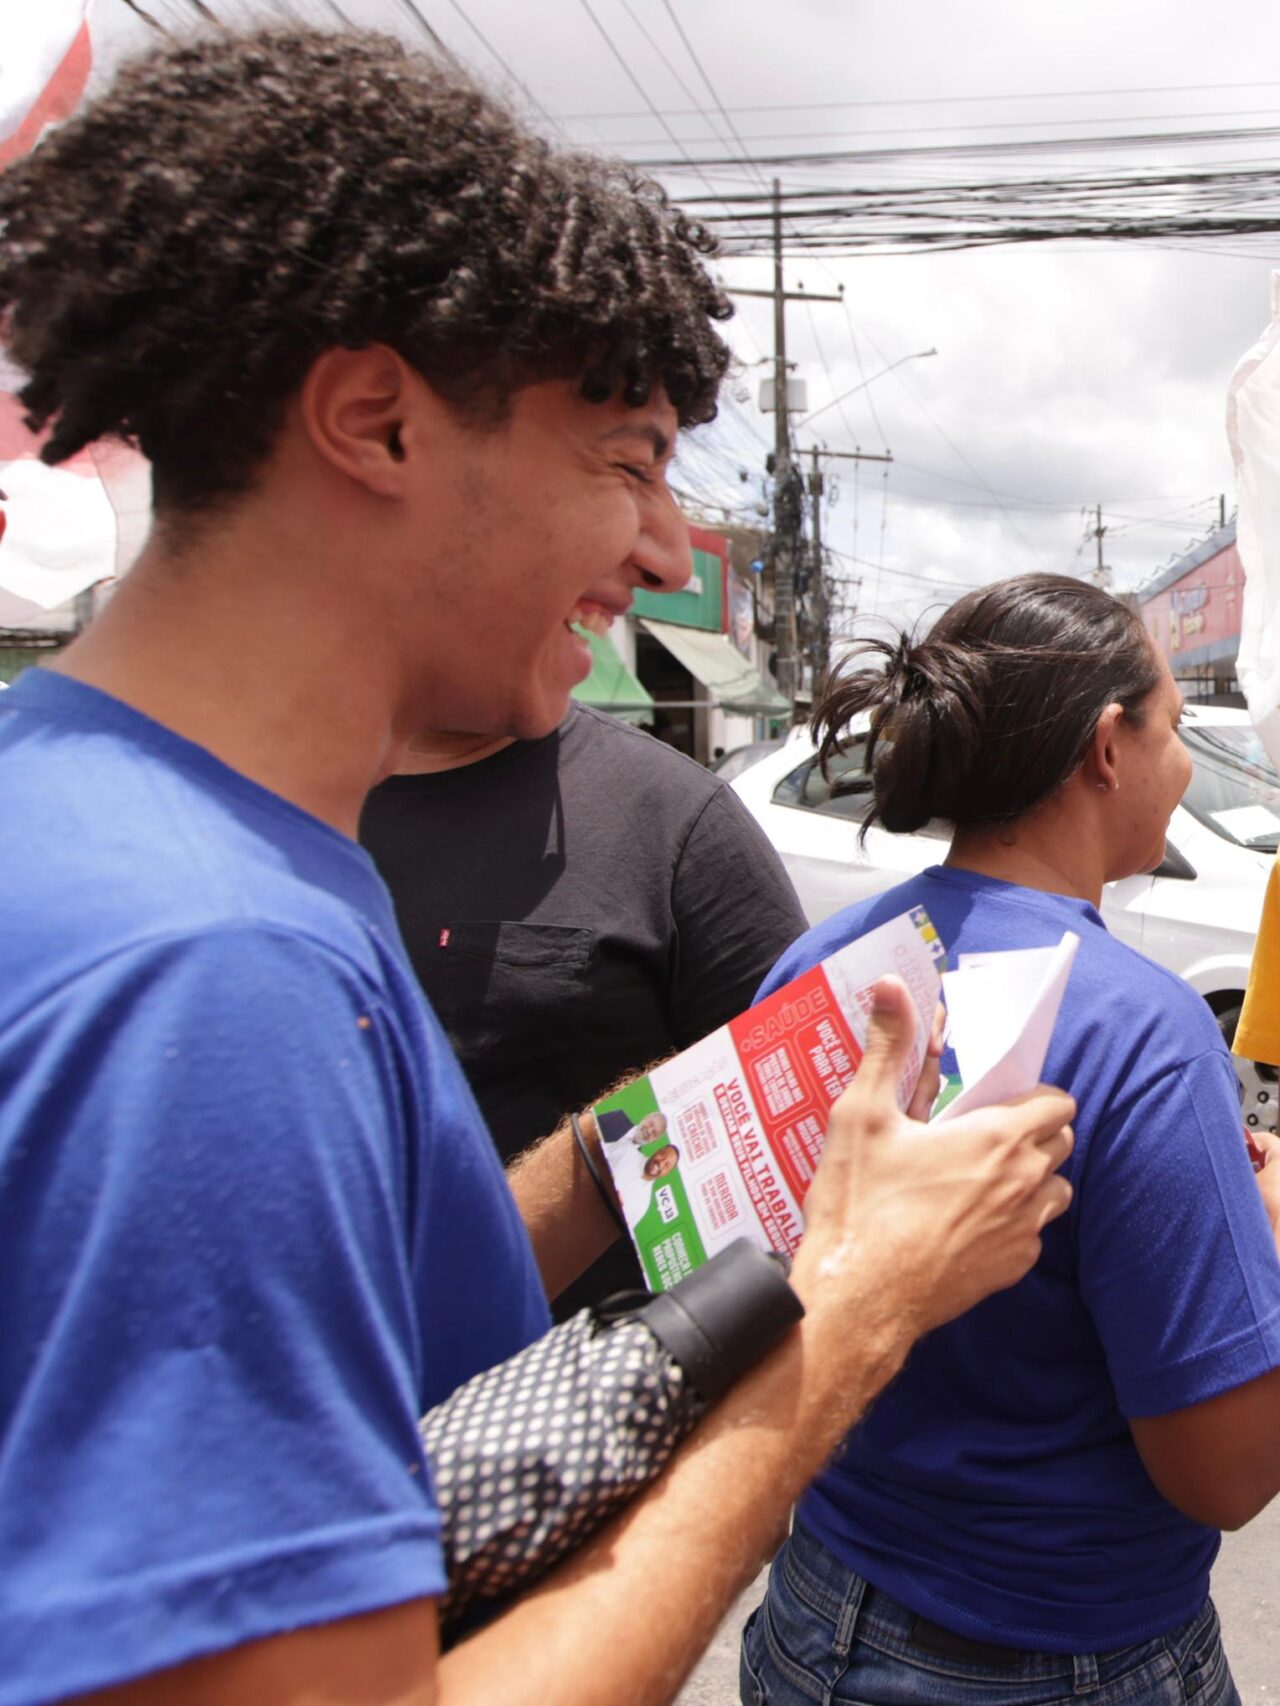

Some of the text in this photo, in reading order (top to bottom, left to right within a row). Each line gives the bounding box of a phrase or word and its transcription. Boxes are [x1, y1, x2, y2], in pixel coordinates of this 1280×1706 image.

[725, 1077, 754, 1126] VOCÊ
[742, 1127, 762, 1162] VAI
[755, 1164, 805, 1249] TRABALH
[715, 1172, 737, 1220] MERENDA
[764, 1218, 791, 1257] SEGUR
